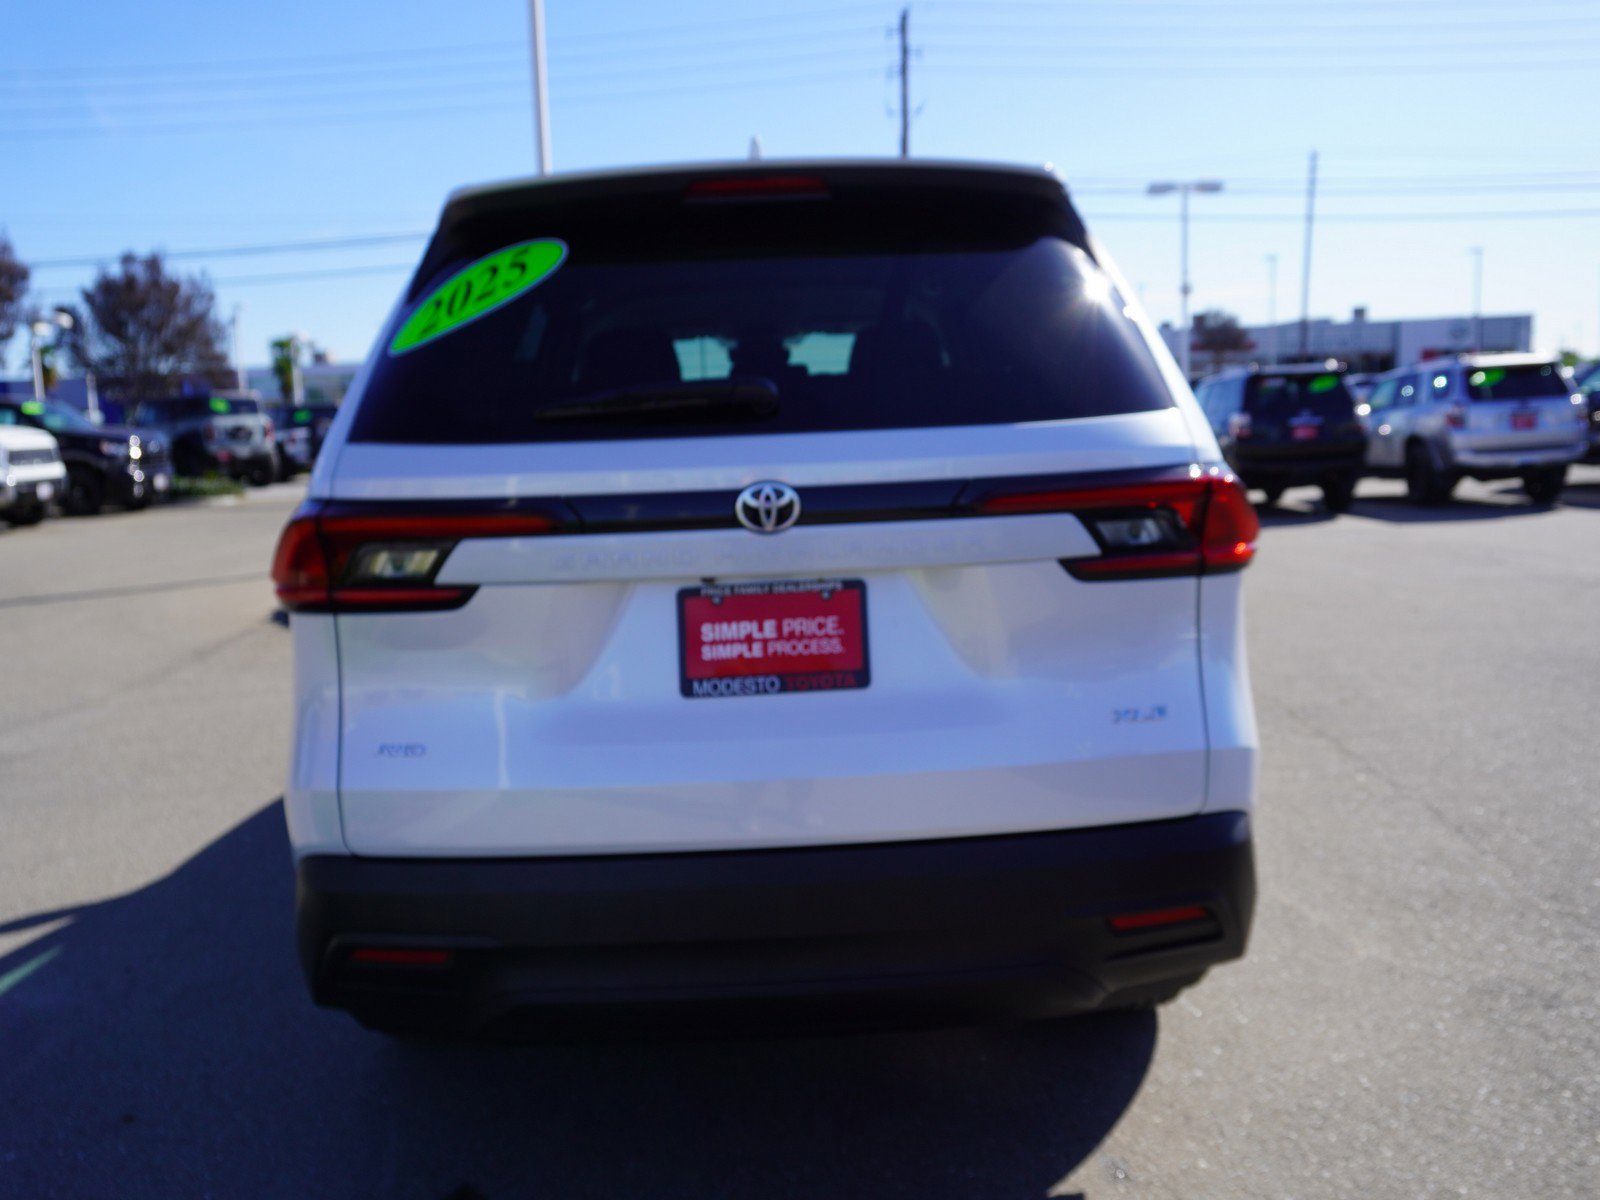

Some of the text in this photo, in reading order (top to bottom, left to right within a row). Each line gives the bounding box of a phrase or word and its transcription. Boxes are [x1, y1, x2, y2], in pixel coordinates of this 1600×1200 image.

[416, 248, 530, 338] 2025
[701, 616, 845, 643] SIMPLE PRICE.
[701, 642, 764, 661] SIMPLE
[693, 672, 858, 697] MODESTO TOYOTA
